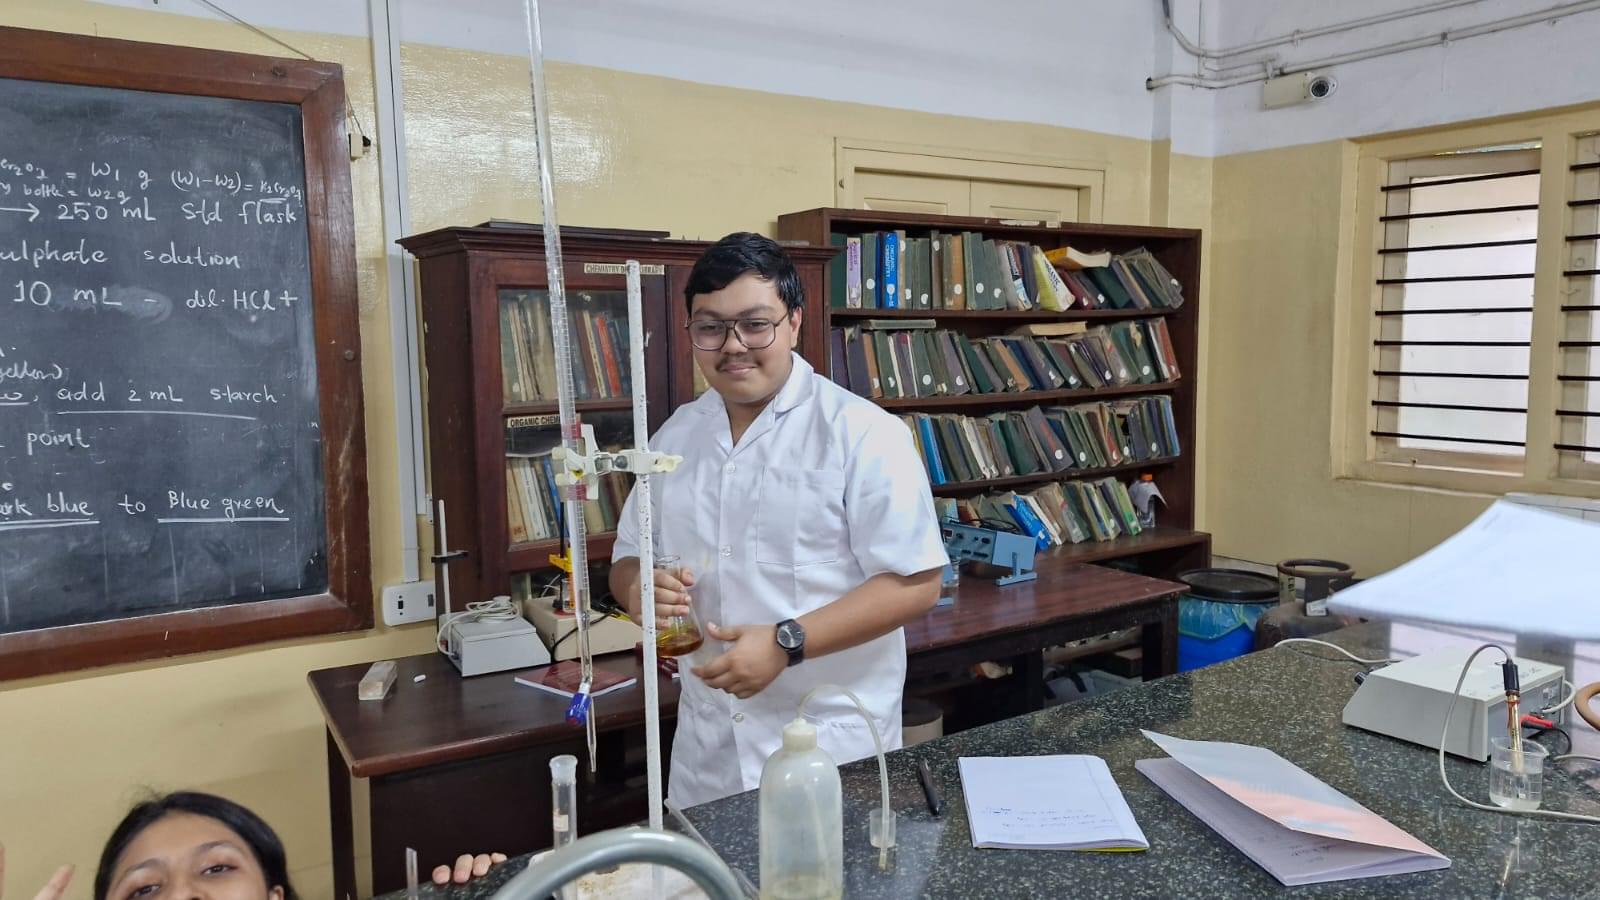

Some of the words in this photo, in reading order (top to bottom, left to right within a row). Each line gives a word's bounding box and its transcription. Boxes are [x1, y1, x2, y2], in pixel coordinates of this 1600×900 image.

[57, 202, 108, 221] 250
[122, 197, 157, 221] mL
[238, 200, 297, 225] flask
[143, 240, 241, 269] solution
[13, 279, 51, 306] 10
[73, 287, 122, 306] mL
[57, 381, 105, 402] add
[127, 388, 142, 402] 2
[150, 385, 184, 402] mL
[510, 417, 540, 428] ORGANIC
[27, 428, 91, 456] point
[47, 491, 94, 516] blue
[117, 494, 147, 516] to
[168, 490, 211, 511] Blue
[221, 495, 285, 523] green
